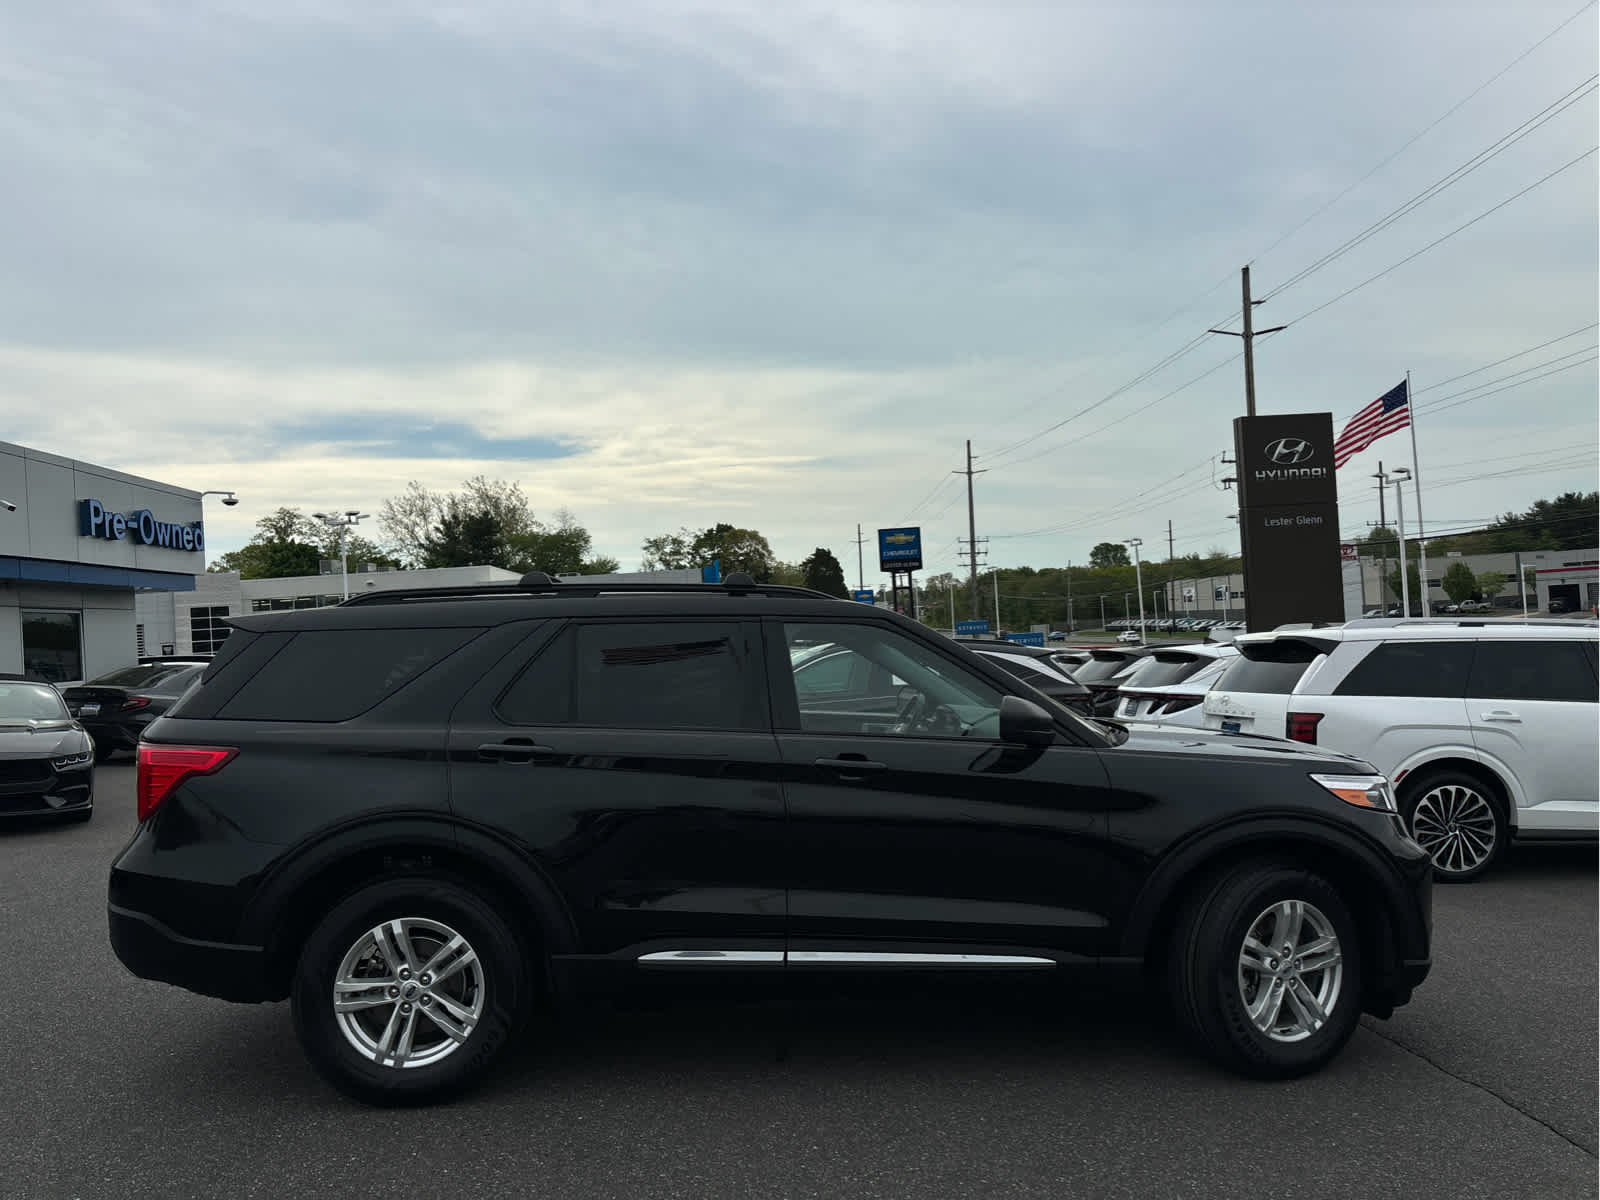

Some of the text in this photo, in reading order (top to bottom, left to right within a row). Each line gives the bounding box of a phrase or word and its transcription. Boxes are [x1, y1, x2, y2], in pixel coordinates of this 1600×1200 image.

[1255, 467, 1327, 480] HYUNDAI
[87, 498, 204, 552] Pre-Owned
[1264, 515, 1323, 527] Lester Glenn
